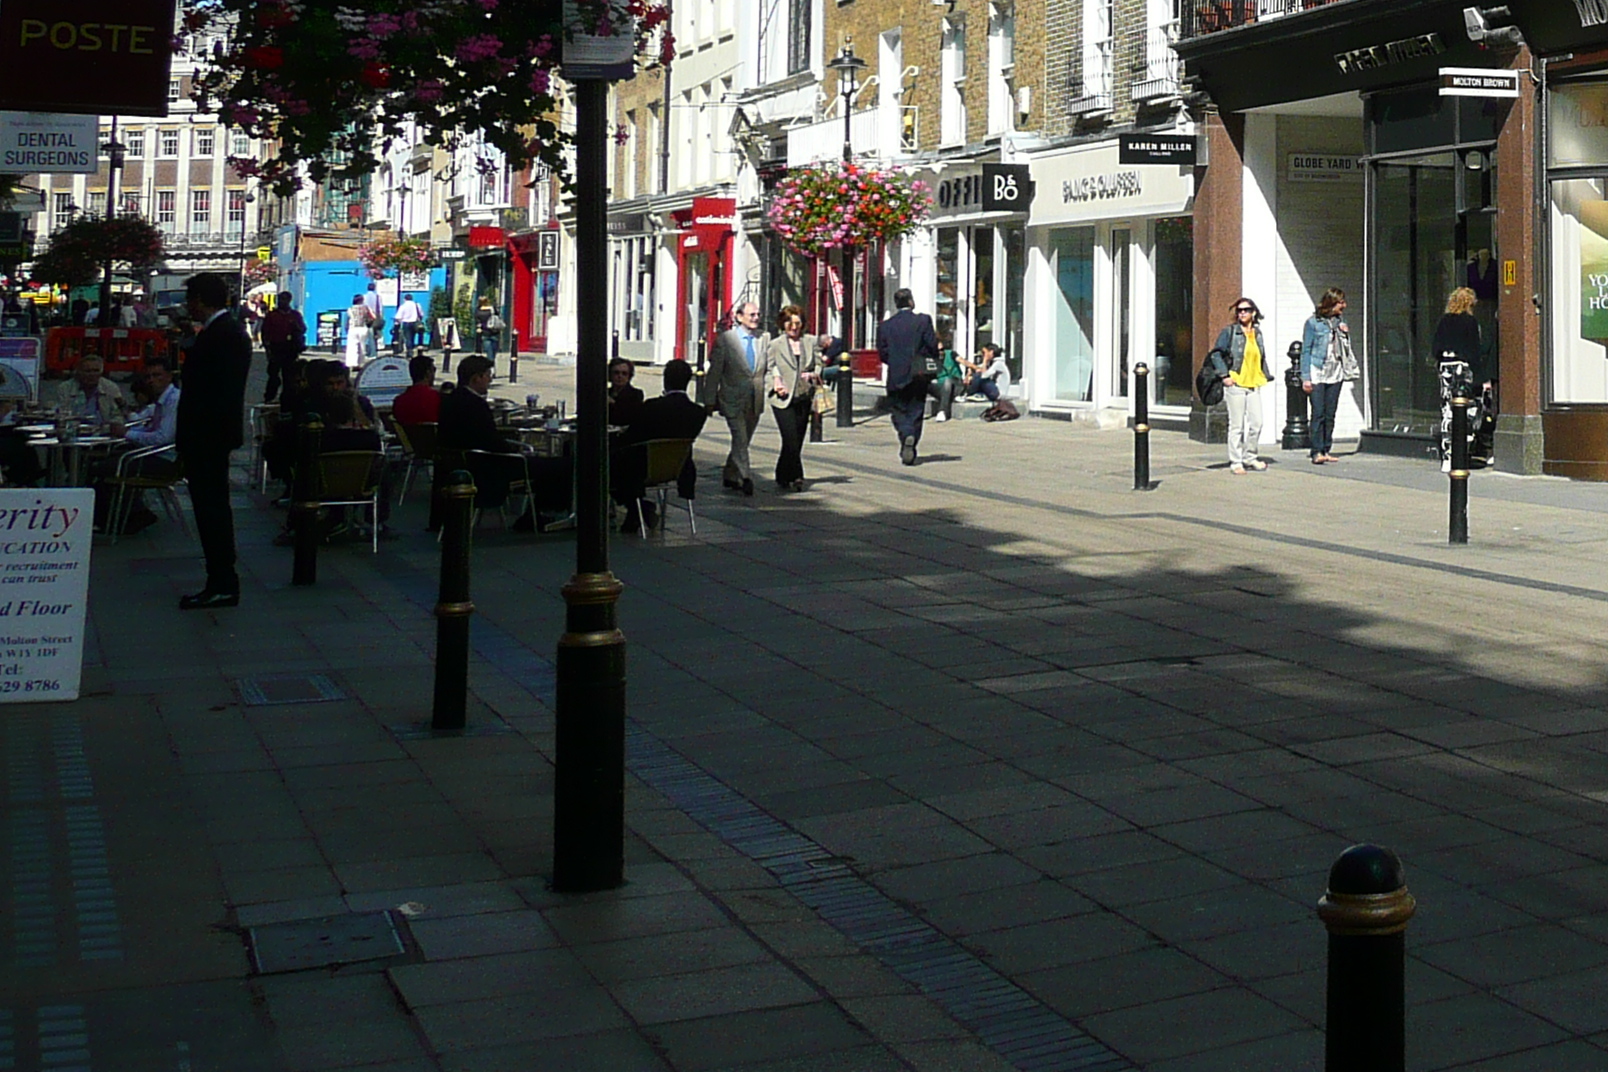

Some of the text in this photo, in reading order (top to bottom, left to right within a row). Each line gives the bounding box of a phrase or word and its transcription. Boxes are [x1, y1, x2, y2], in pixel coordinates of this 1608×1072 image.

[20, 19, 155, 54] POSTE
[1453, 77, 1510, 88] MOLTON BROWN
[18, 132, 76, 147] DENTAL
[1128, 142, 1192, 151] KAREN MILLEN
[5, 151, 88, 166] SURGEONS
[1294, 157, 1323, 168] GLOBE
[1326, 158, 1352, 170] YARD
[6, 562, 78, 572] recruitment
[28, 574, 58, 582] trust
[16, 600, 72, 616] Floor
[41, 636, 73, 644] Street
[25, 680, 60, 692] 8786
